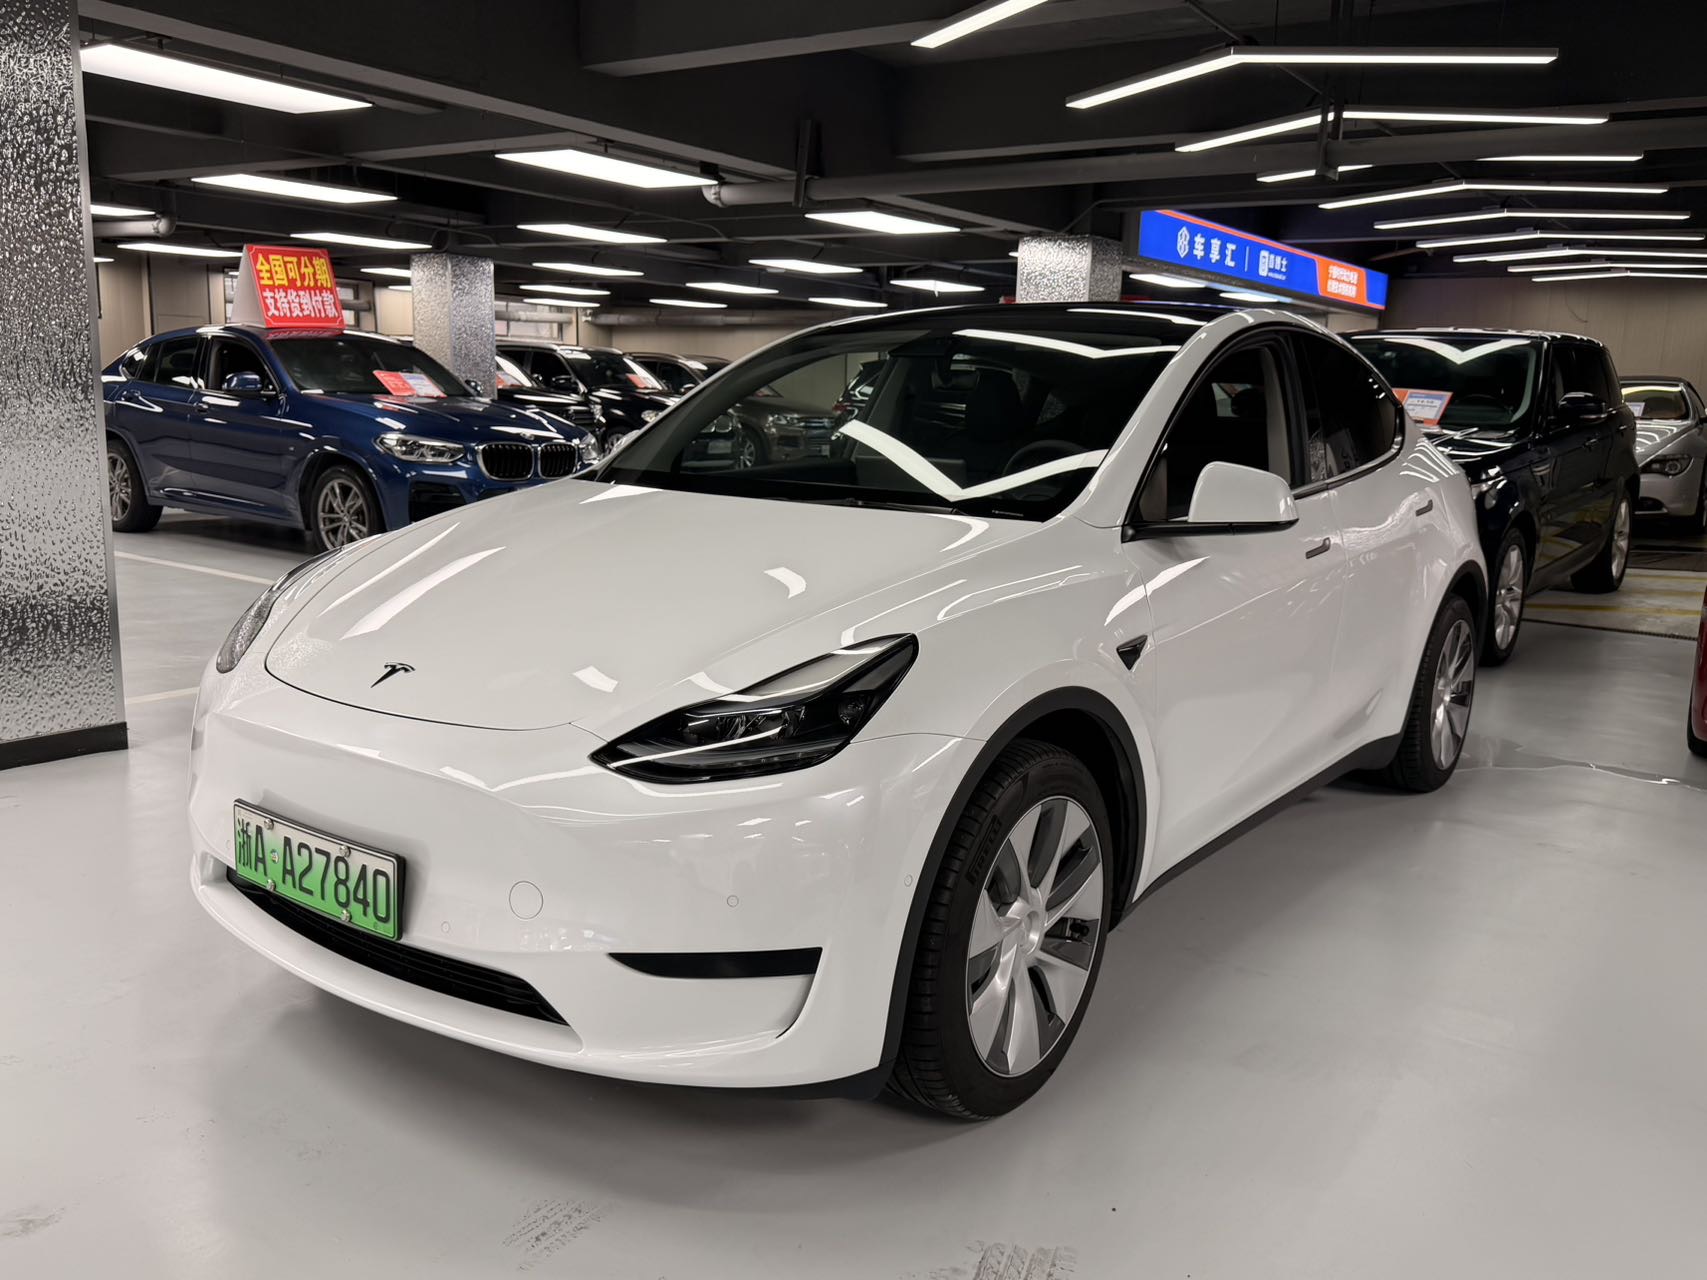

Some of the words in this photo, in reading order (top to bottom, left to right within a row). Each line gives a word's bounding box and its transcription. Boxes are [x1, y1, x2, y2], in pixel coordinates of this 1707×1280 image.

[1193, 233, 1237, 267] 车享汇
[256, 253, 332, 288] 全国可分期
[262, 287, 338, 318] 支持货到付款
